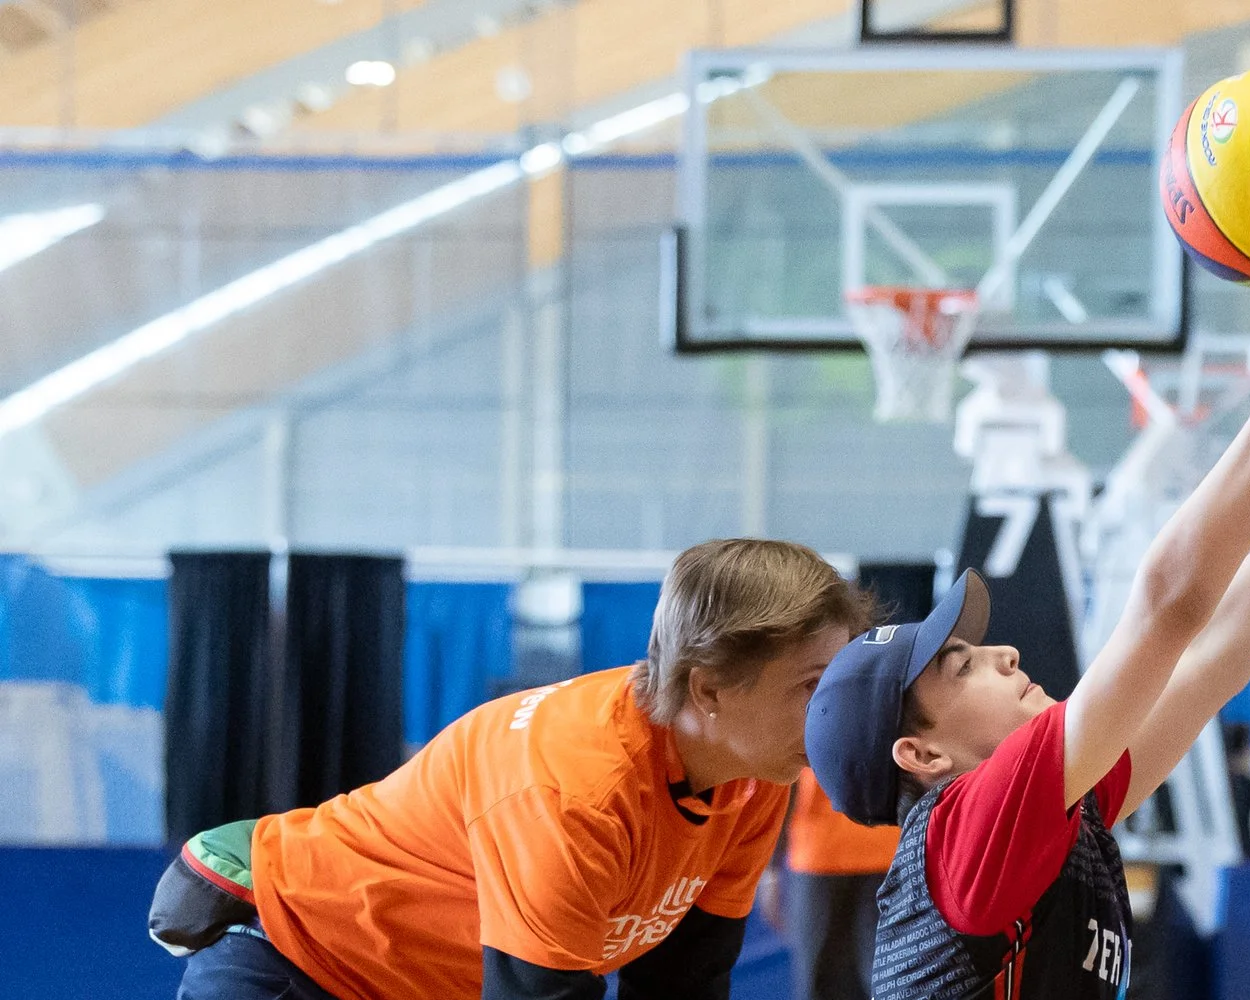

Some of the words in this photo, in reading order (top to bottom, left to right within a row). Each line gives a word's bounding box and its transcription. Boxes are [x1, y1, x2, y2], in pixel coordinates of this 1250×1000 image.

[979, 498, 1040, 577] 7
[907, 927, 930, 944] MADOC
[886, 944, 918, 964] PICKERING
[919, 932, 951, 951] OSHAWA
[879, 963, 908, 979] HAMILTON
[934, 983, 964, 999] RIVER
